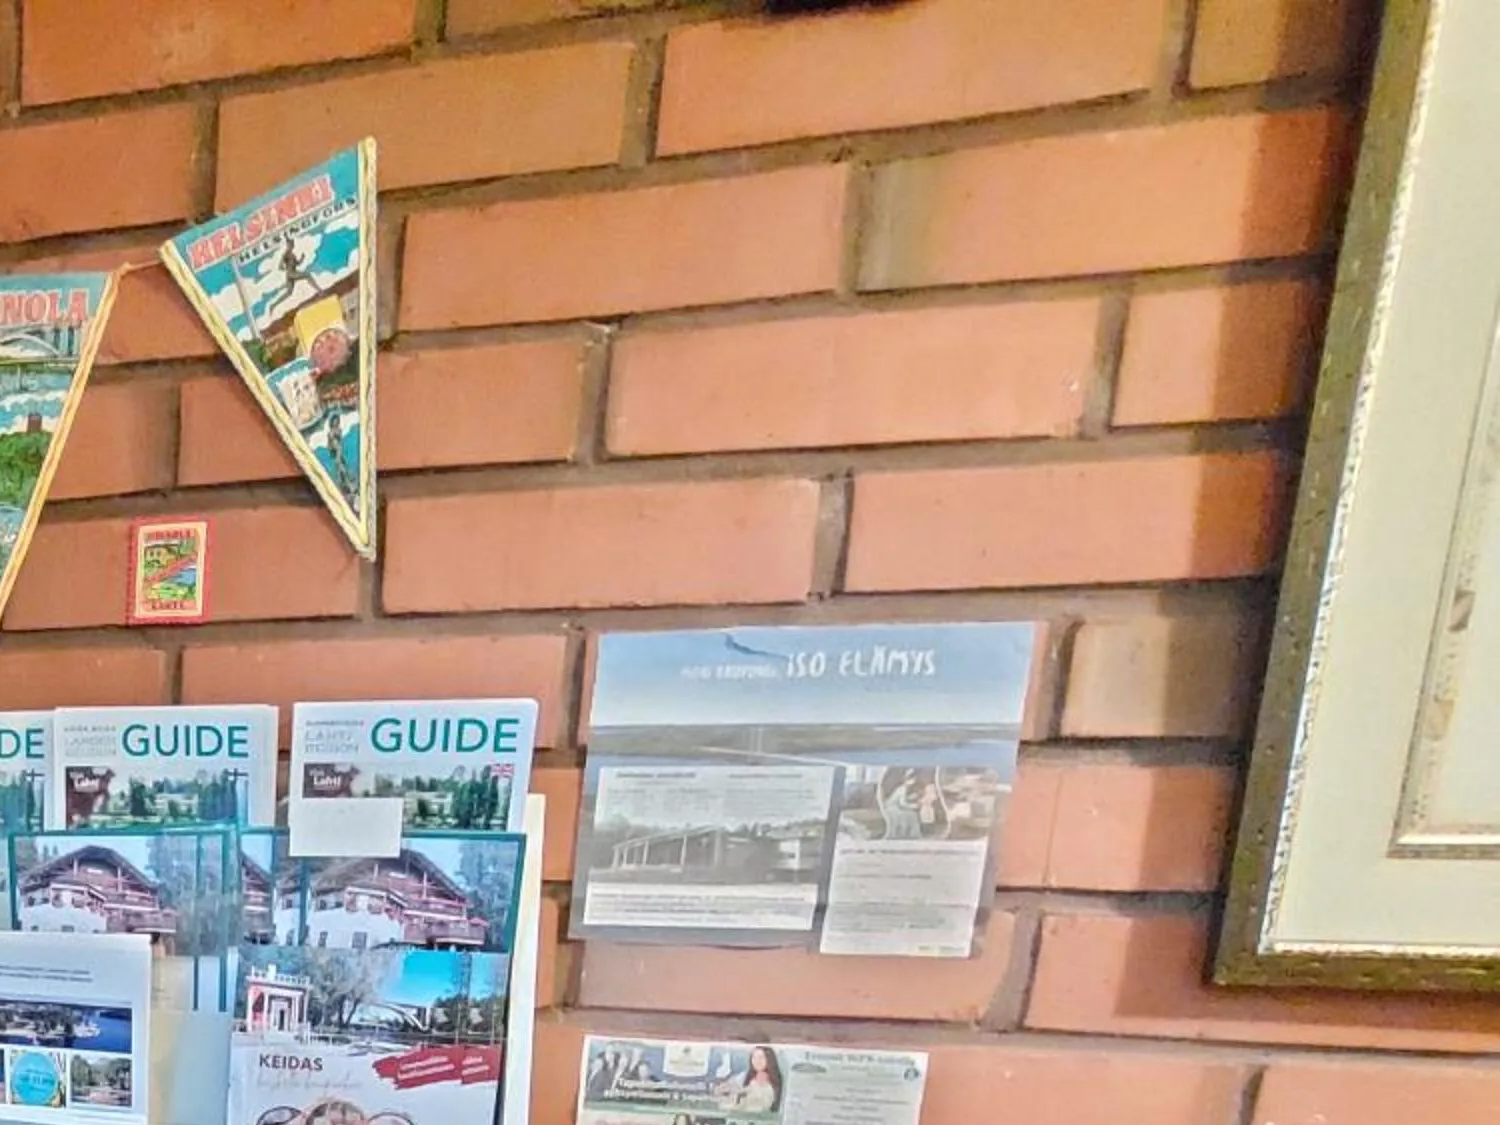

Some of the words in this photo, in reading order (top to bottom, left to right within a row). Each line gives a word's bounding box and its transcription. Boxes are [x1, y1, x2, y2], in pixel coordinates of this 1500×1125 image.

[187, 172, 335, 272] HELSINKI
[786, 651, 826, 678] ISO
[122, 724, 249, 758] GUIDE
[370, 716, 521, 753] GUIDE
[258, 1053, 323, 1072] KEIDAS
